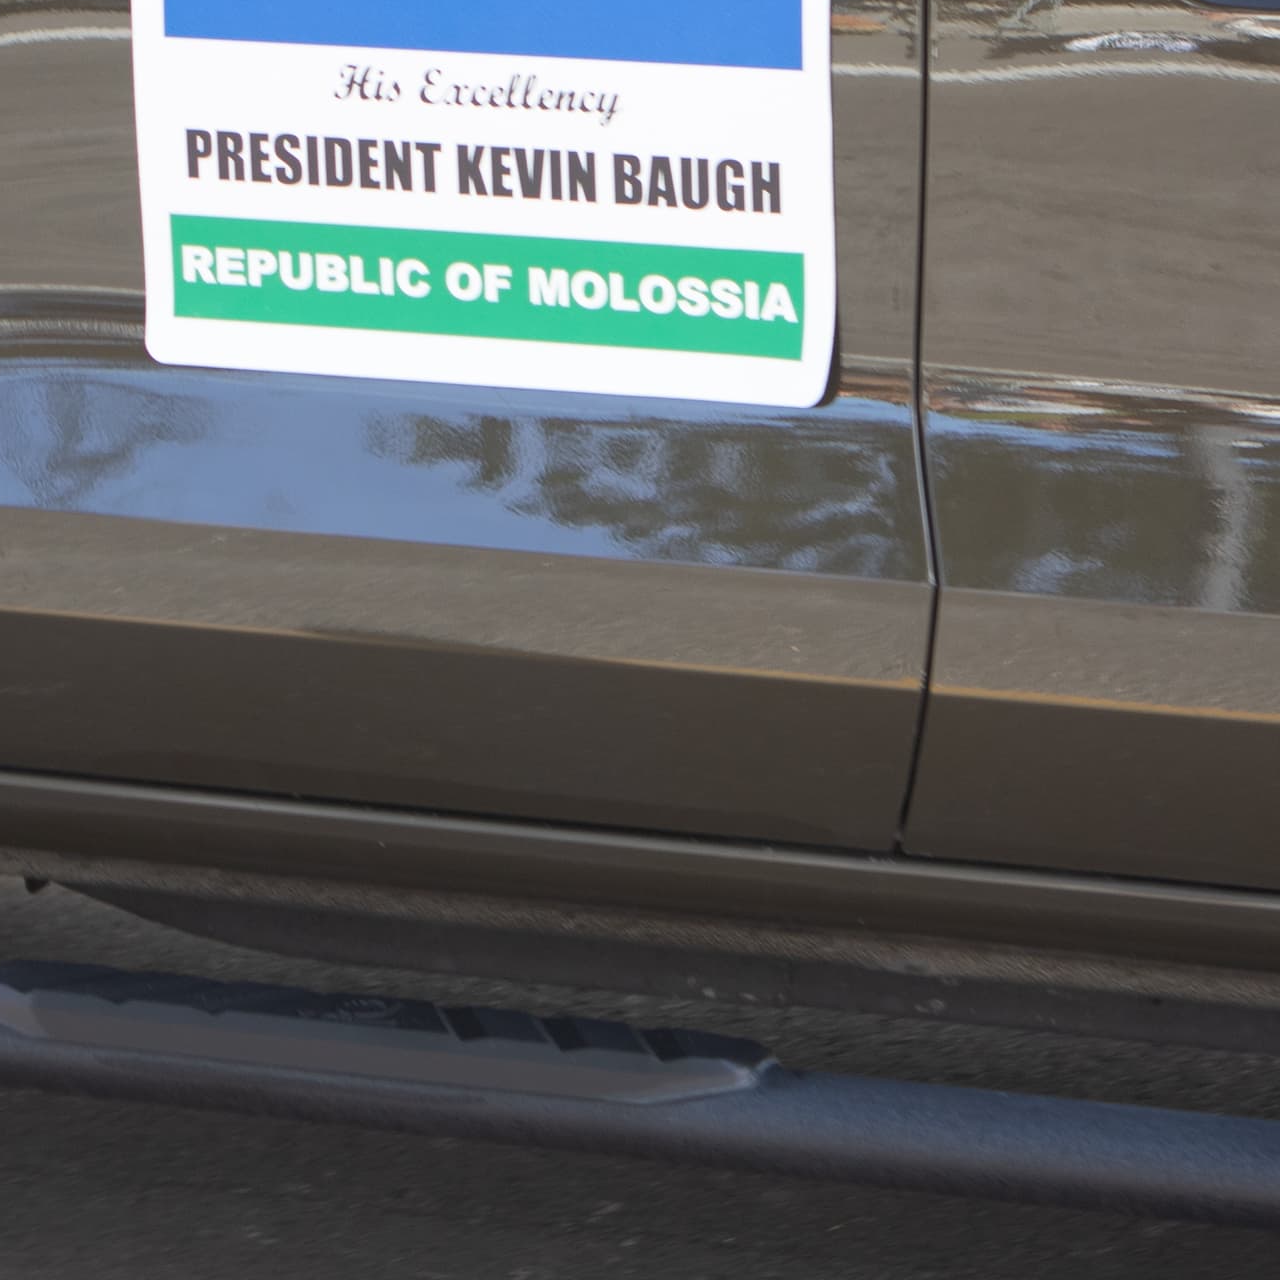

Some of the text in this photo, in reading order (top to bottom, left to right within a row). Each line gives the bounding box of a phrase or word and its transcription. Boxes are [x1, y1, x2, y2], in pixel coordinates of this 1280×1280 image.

[334, 64, 620, 125] His Excellency
[185, 129, 781, 214] PRESIDENT KEVIN BAUGH
[181, 245, 799, 324] REPUBLIC OF MOLOSSIA
